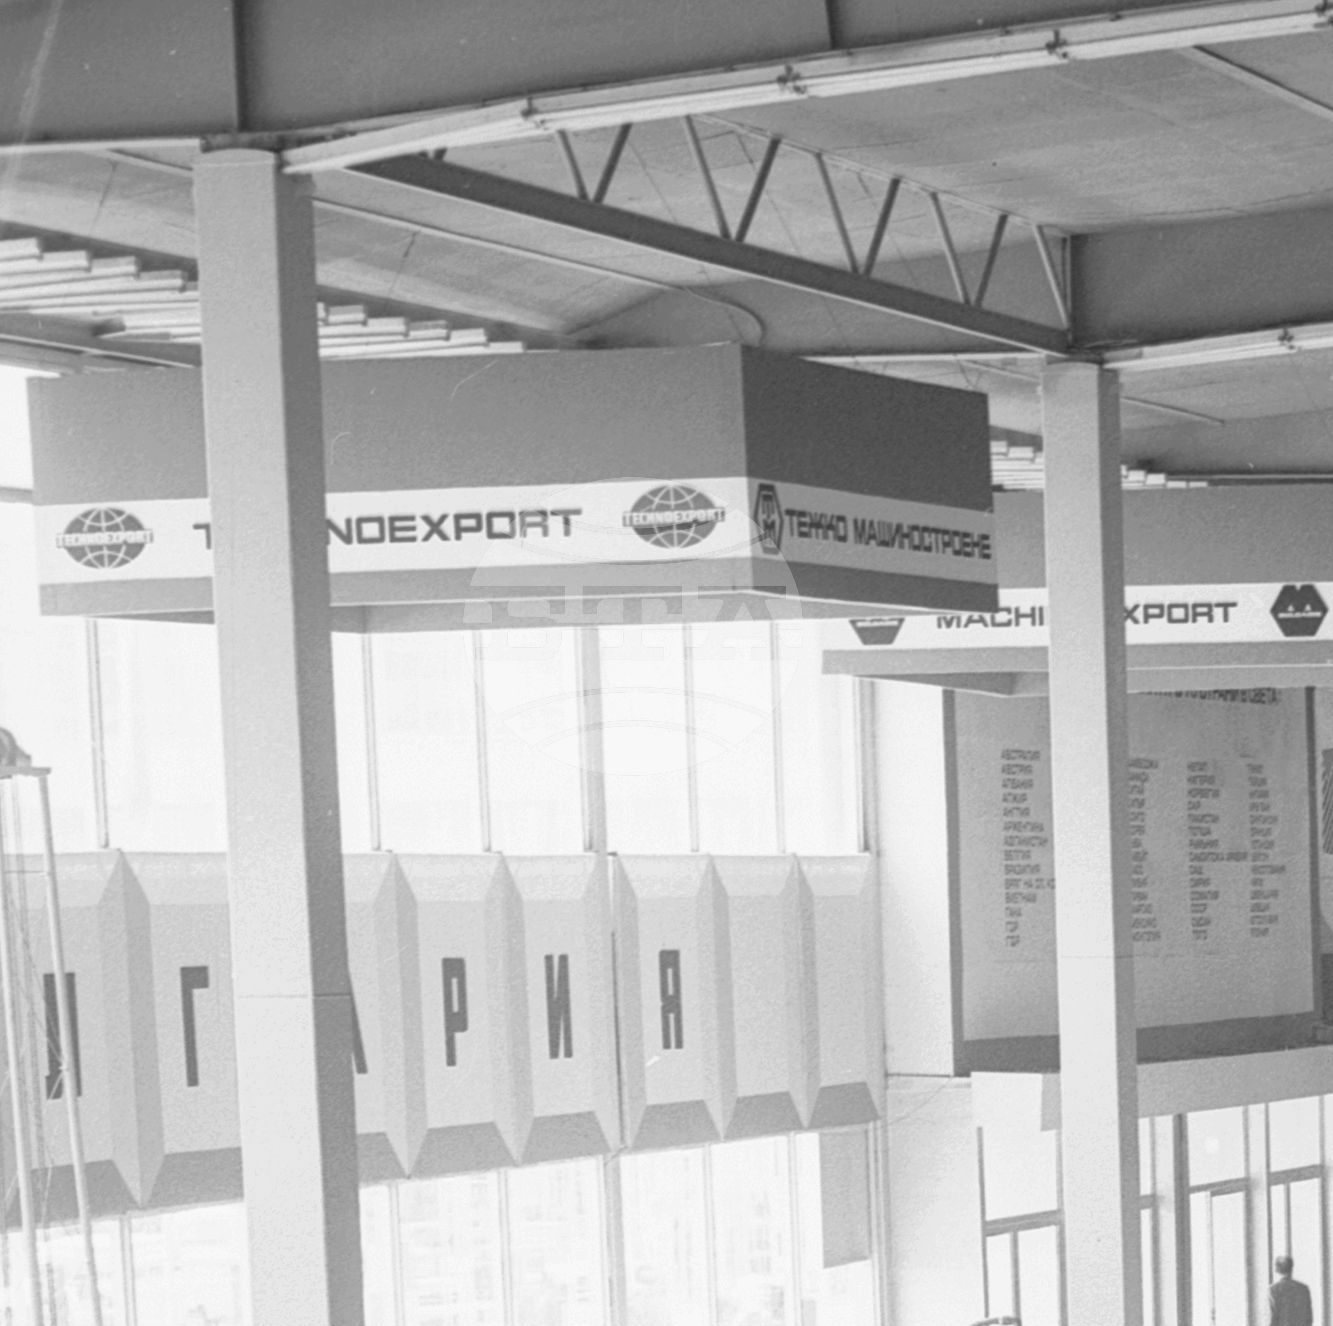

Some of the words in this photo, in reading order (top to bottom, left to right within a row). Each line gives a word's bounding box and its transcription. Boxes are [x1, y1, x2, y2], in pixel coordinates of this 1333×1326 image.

[193, 508, 582, 550] TNOEXPORT
[622, 506, 727, 527] TECHNOEXPORT
[937, 602, 1238, 630] MACHIXPORT
